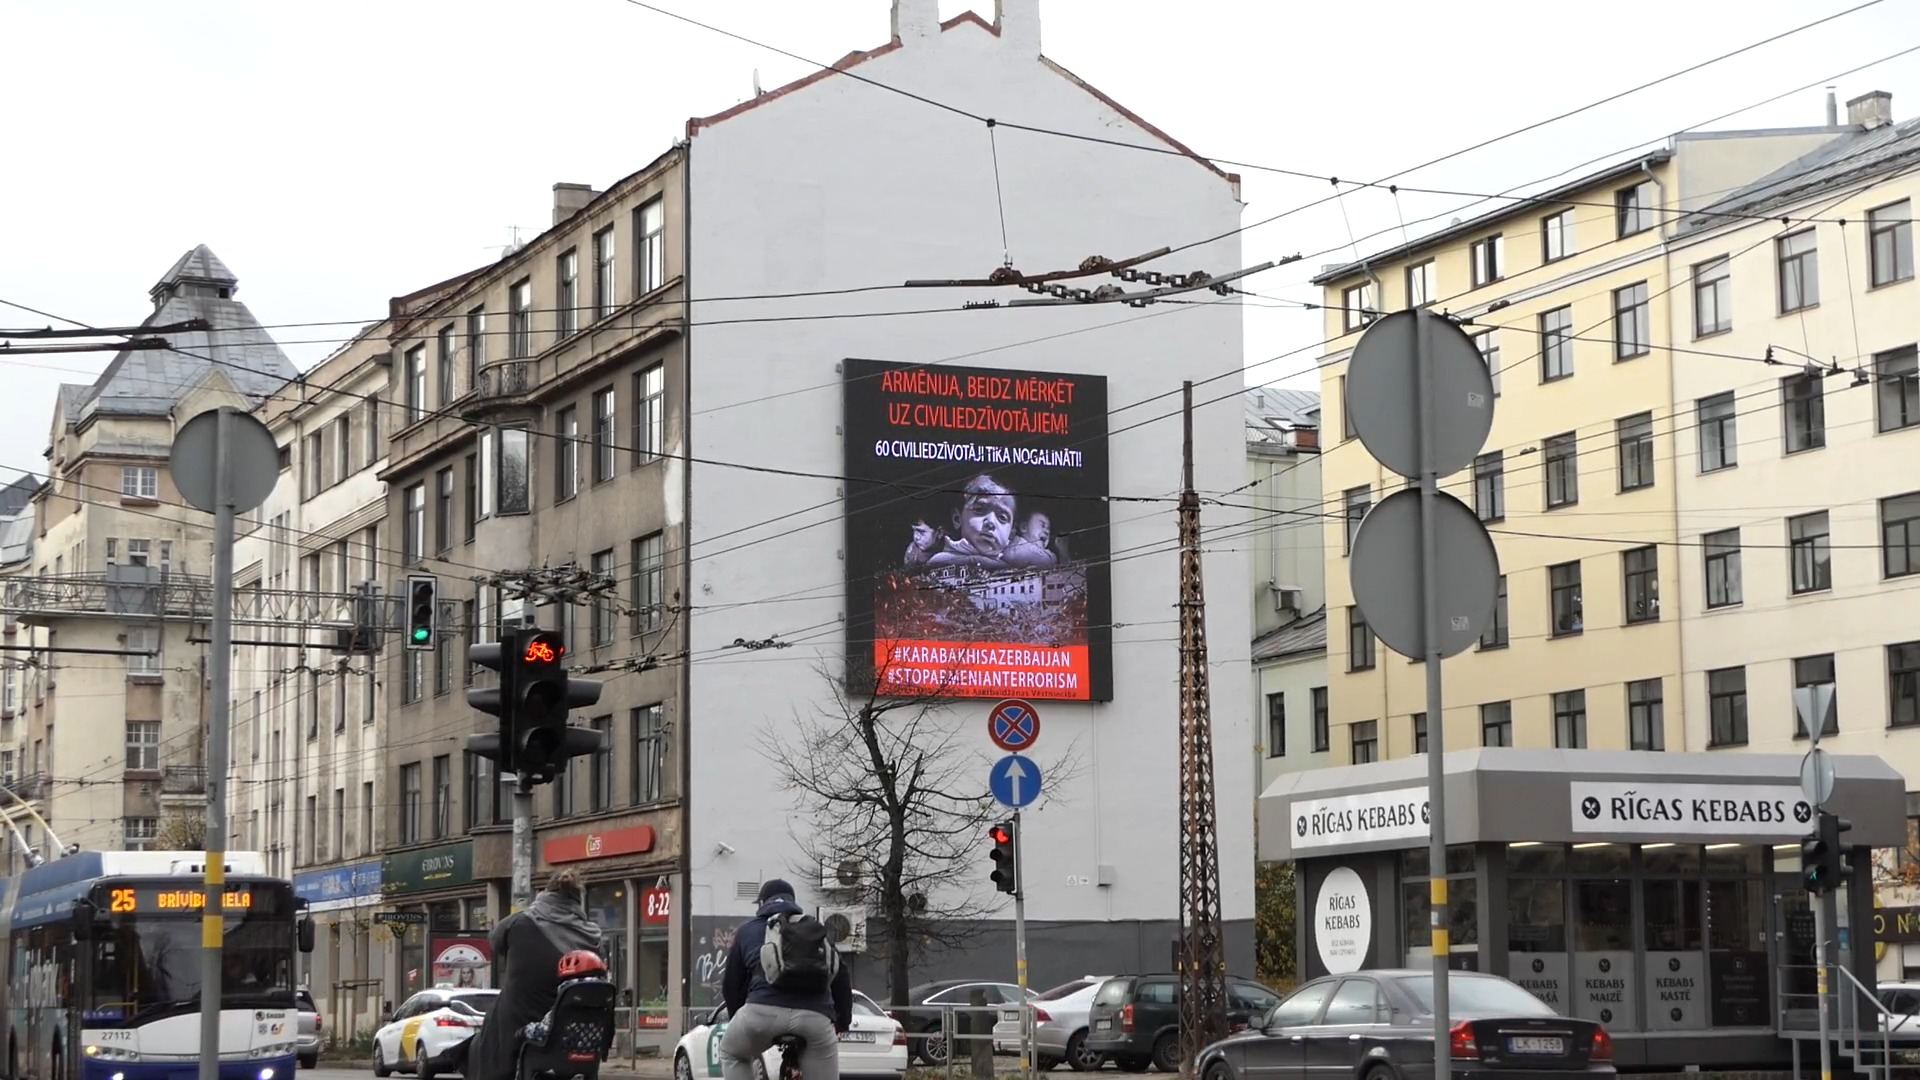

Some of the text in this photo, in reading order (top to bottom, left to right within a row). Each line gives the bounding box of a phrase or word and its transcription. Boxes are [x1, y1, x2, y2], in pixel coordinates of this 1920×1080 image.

[882, 369, 1075, 408] ARMĒNIJA, BEIDZ MĒRĶĒT
[889, 403, 1068, 434] UZ CIVILIEDZĪVOTĀJIEM!
[875, 440, 890, 457] 60
[986, 446, 1011, 463] TIKA
[1013, 448, 1082, 467] NOGALINĀTI!
[894, 646, 1071, 667] #KARABAKHISAZERBAIJAN
[887, 668, 1079, 689] #STOPARMENIANTERRORISM
[1358, 803, 1416, 831] KEBABS
[1692, 799, 1786, 823] KEBABS
[111, 889, 136, 912] 25
[648, 892, 670, 917] 8-22
[1324, 914, 1361, 931] KEBABS
[1518, 979, 1559, 989] KEBABS
[1585, 979, 1625, 989] KEBABS
[1656, 977, 1695, 988] KEBABS
[101, 1031, 132, 1041] 27112
